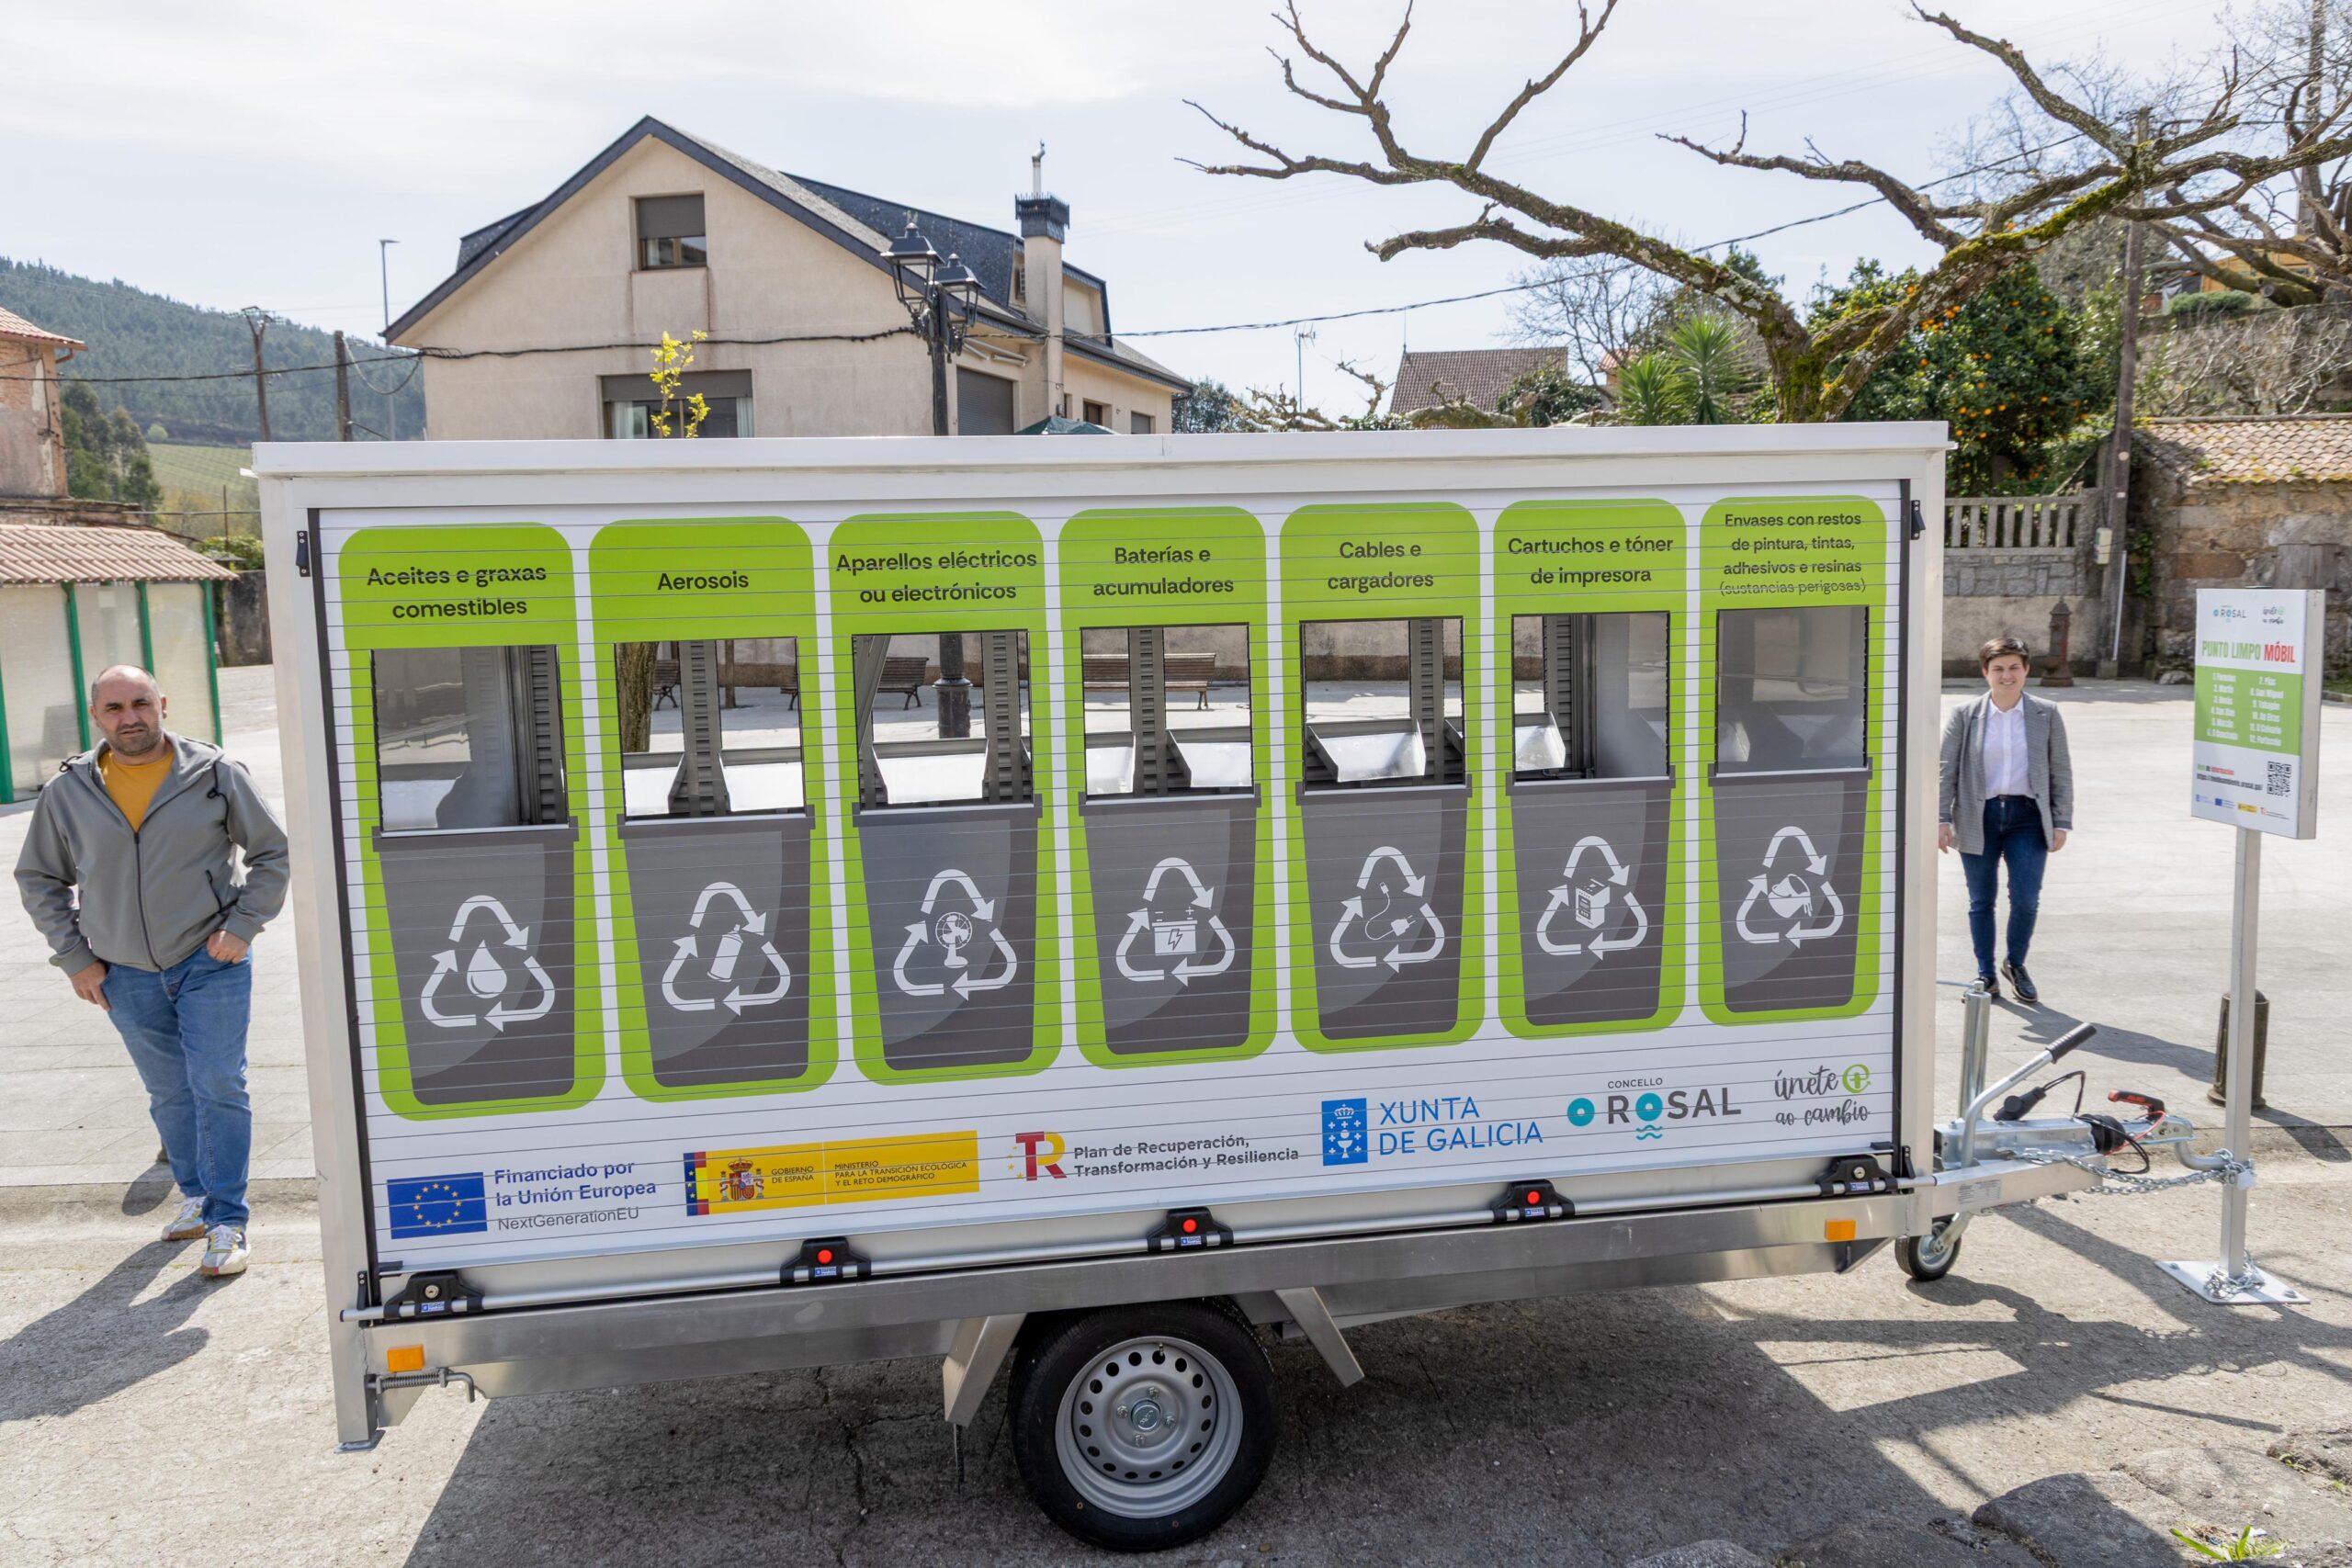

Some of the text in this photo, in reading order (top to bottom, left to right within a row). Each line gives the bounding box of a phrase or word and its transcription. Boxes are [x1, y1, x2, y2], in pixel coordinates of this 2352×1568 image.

[1724, 513, 1861, 527] Envases con restos
[1114, 546, 1211, 566] Baterías e
[1339, 540, 1422, 559] Cables e
[1508, 535, 1674, 555] Cartuchos e tóner
[1731, 536, 1856, 554] de pintura, tintas,
[836, 549, 1037, 576] Aparellos eléctricos
[1724, 559, 1862, 575] adhesivos e resinas
[367, 564, 547, 588] Aceites e graxas
[657, 570, 750, 592] Aerosois
[1093, 577, 1234, 597] acumuladores
[1328, 571, 1434, 593] cargadores
[1531, 566, 1651, 588] de impresora
[1720, 577, 1867, 596] (sustancias perigosas)
[859, 582, 1017, 604] ou electrónicos
[392, 597, 527, 620] comestibles
[2202, 640, 2296, 663] PUNTO LIMPO MÓBIL
[1607, 1077, 1663, 1089] CONCELLO
[1774, 1065, 1838, 1101] únete
[1379, 1096, 1480, 1126] XUNTA
[1607, 1087, 1742, 1125] ROSAL
[1775, 1099, 1870, 1126] ao cambio
[1074, 1135, 1250, 1159] Plan de Recuperación,
[1379, 1121, 1544, 1156] DE GALICIA
[494, 1160, 635, 1185] Financiado por
[771, 1165, 814, 1176] GOBIERNO
[834, 1160, 879, 1170] MINISTERIO
[834, 1169, 855, 1179] PARA
[869, 1164, 919, 1176] TRANSICIÓN
[920, 1161, 967, 1172] ECOLÓGICA
[1074, 1148, 1299, 1177] Transformación y Resiliencia
[772, 1172, 814, 1184] DE ESPAÑA
[853, 1177, 876, 1186] RETO
[876, 1171, 935, 1184] DEMOGRÁFICO
[496, 1183, 657, 1207] la Unión Europea
[498, 1206, 639, 1232] NextGenerationEU
